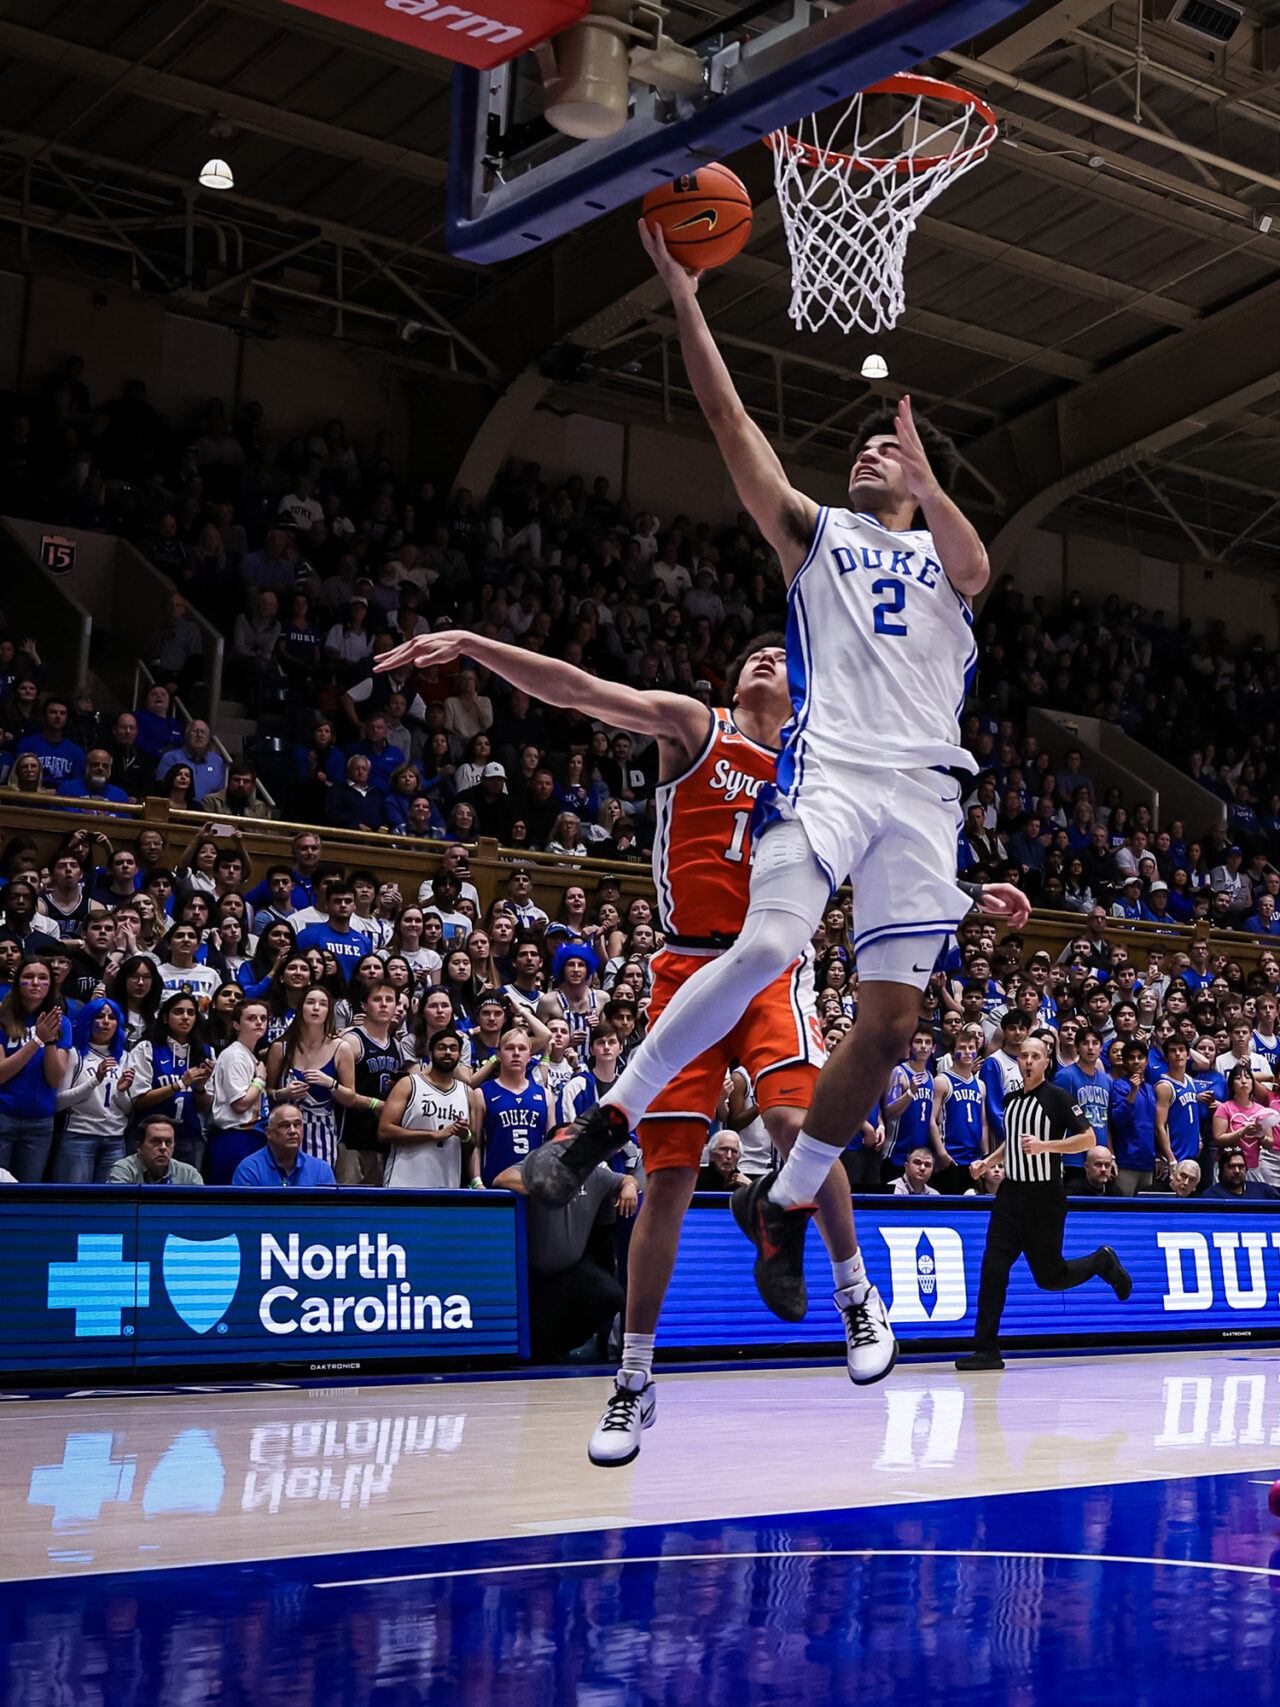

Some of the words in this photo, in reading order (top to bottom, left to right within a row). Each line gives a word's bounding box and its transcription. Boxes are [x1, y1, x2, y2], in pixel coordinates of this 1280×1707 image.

[46, 543, 72, 570] 15
[831, 547, 942, 590] DUKE
[871, 578, 907, 637] 2
[709, 759, 769, 801] Syra
[724, 811, 753, 866] 1
[326, 941, 361, 957] DUKE
[173, 1096, 184, 1124] 1
[953, 1089, 982, 1104] DUKE
[499, 1108, 541, 1129] DUKE
[920, 1101, 926, 1121] 1
[966, 1102, 973, 1123] 1
[1188, 1105, 1194, 1124] 1
[511, 1128, 530, 1155] 5
[261, 1232, 406, 1280] North
[259, 1284, 472, 1334] Carolina
[310, 1362, 361, 1371] DAKTRONICS
